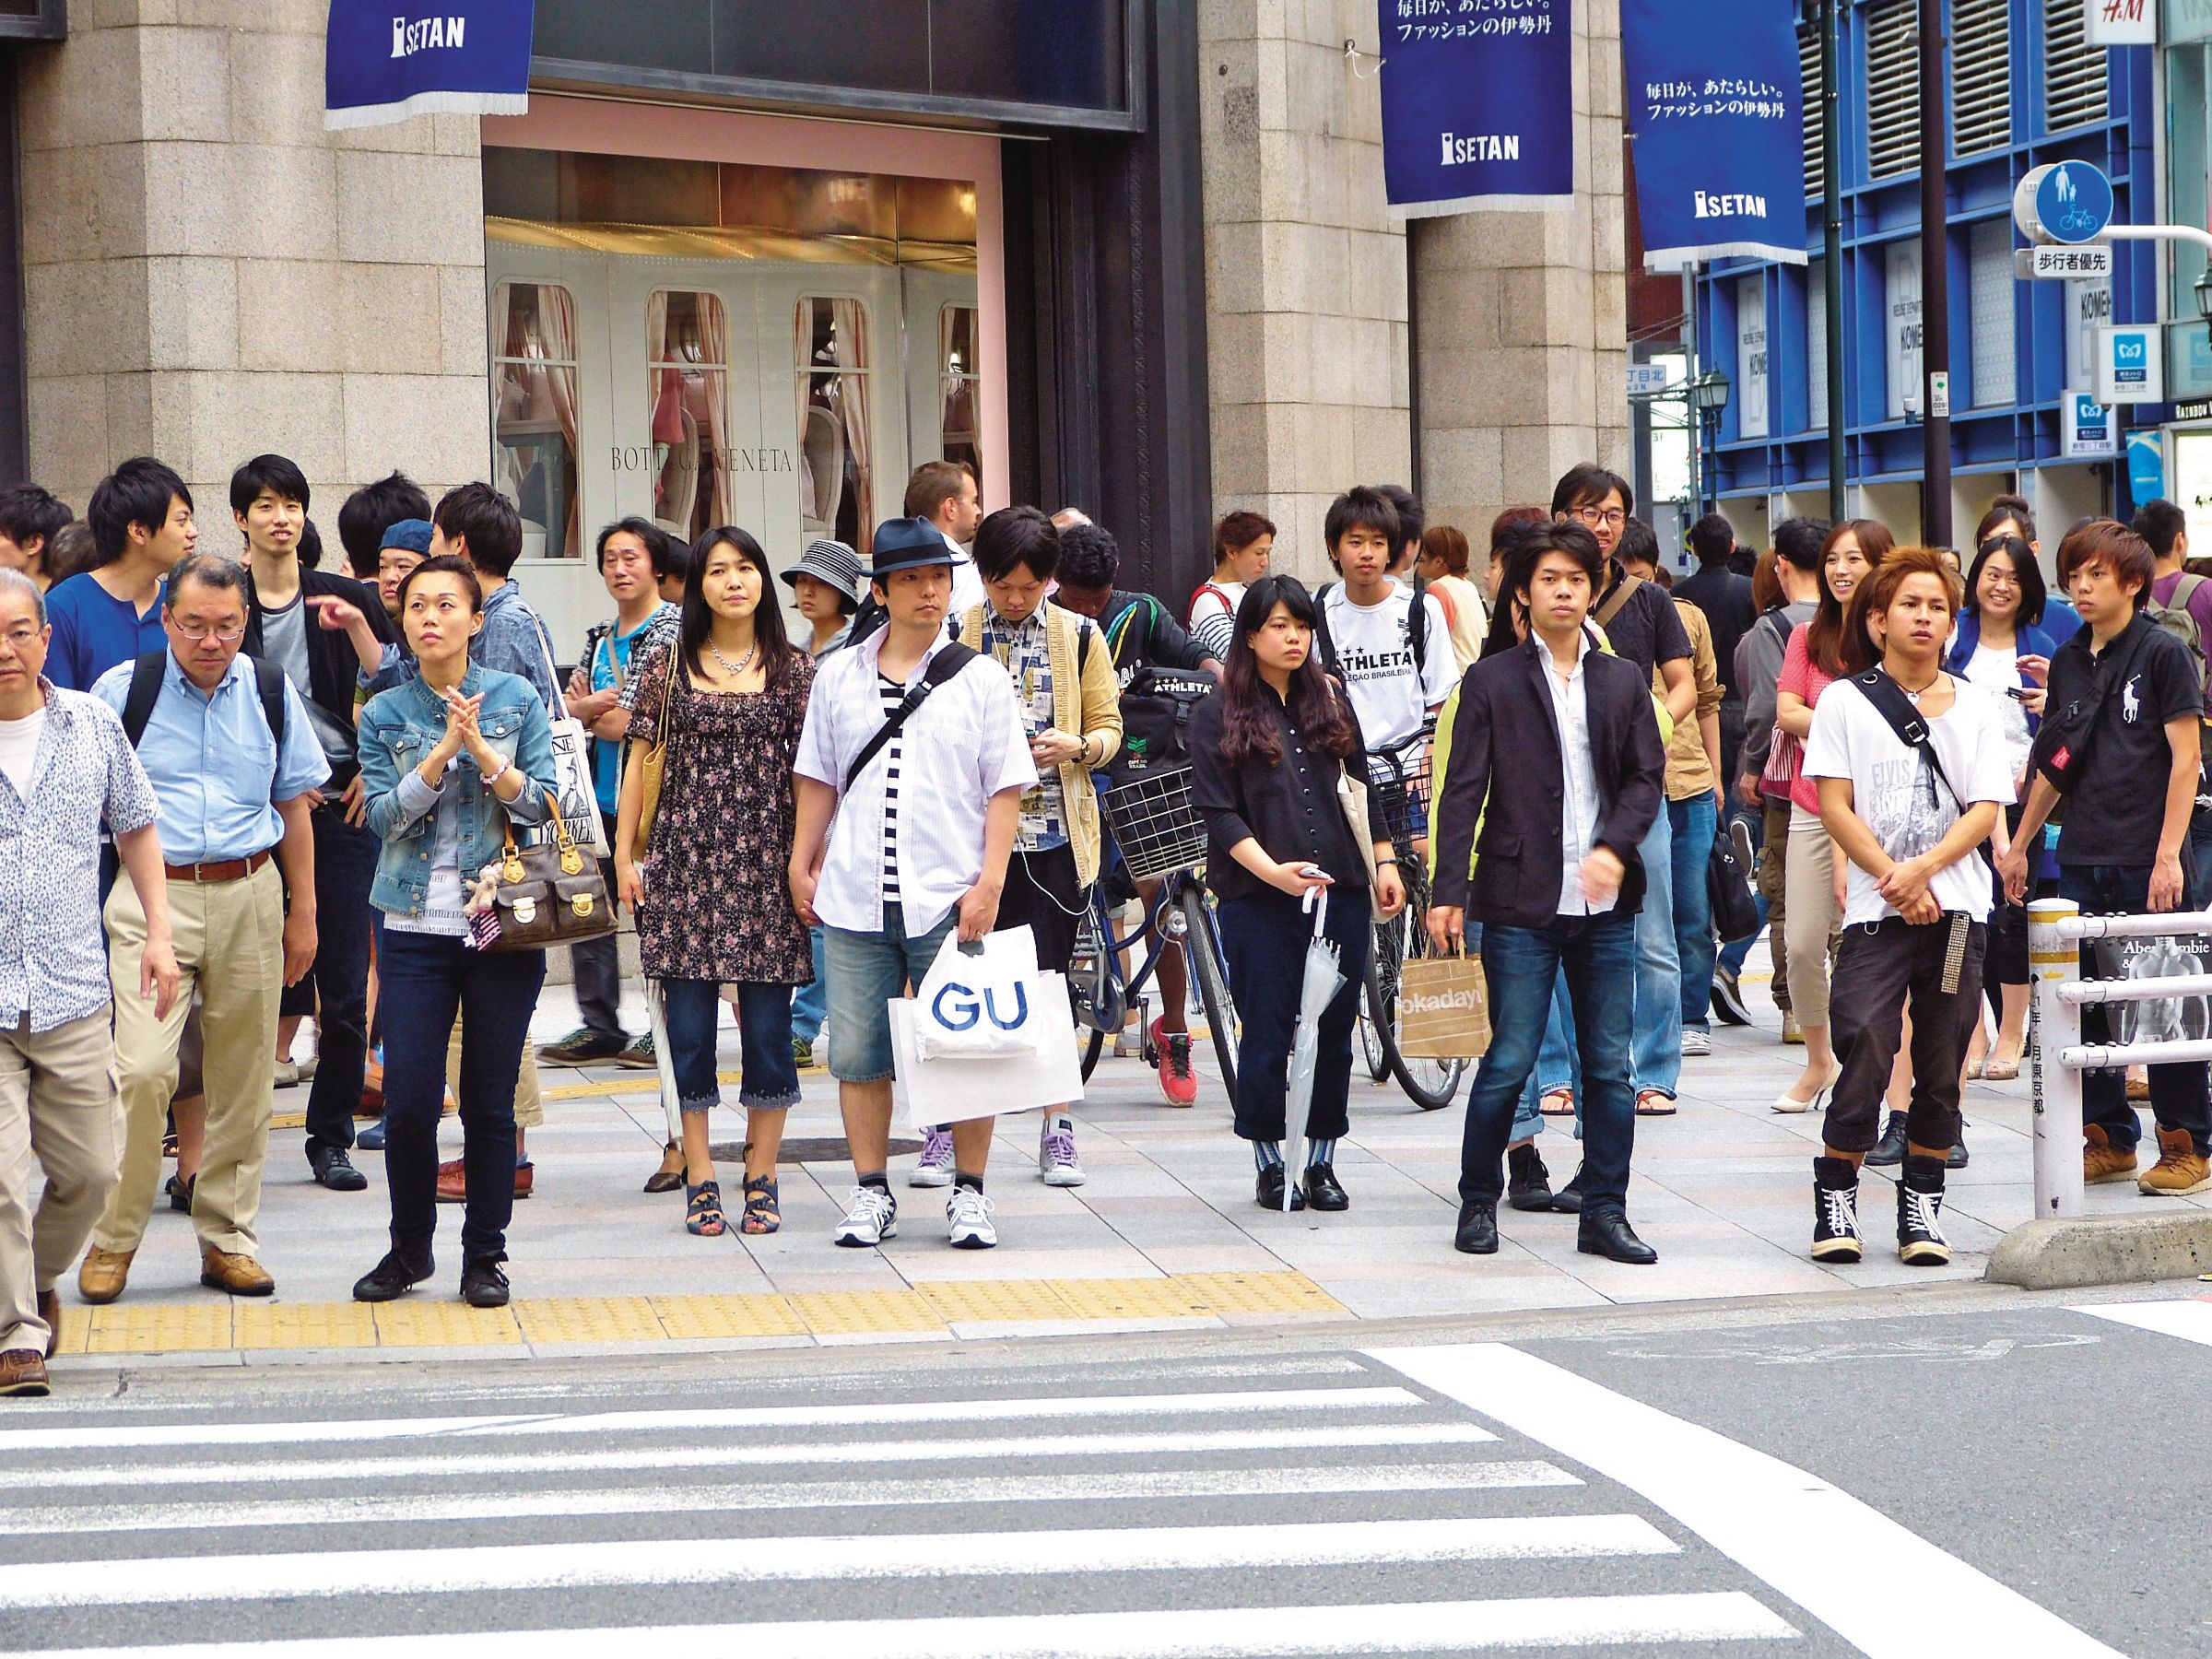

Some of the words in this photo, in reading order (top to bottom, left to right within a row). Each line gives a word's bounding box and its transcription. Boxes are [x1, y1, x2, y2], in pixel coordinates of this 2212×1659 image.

[2102, 0, 2146, 22] H&M
[1397, 14, 1552, 42] ファッションの伊勢丹
[1646, 78, 1783, 100] 毎日が、あたらしい。
[1648, 100, 1786, 121] ファッションの伊勢丹
[2039, 253, 2106, 270] 歩行者優先
[2176, 403, 2207, 419] RAINBOW
[714, 449, 792, 472] VENETA
[1154, 683, 1211, 694] ATHLETA
[1872, 759, 1911, 788] ELVIS
[932, 982, 1028, 1031] GU
